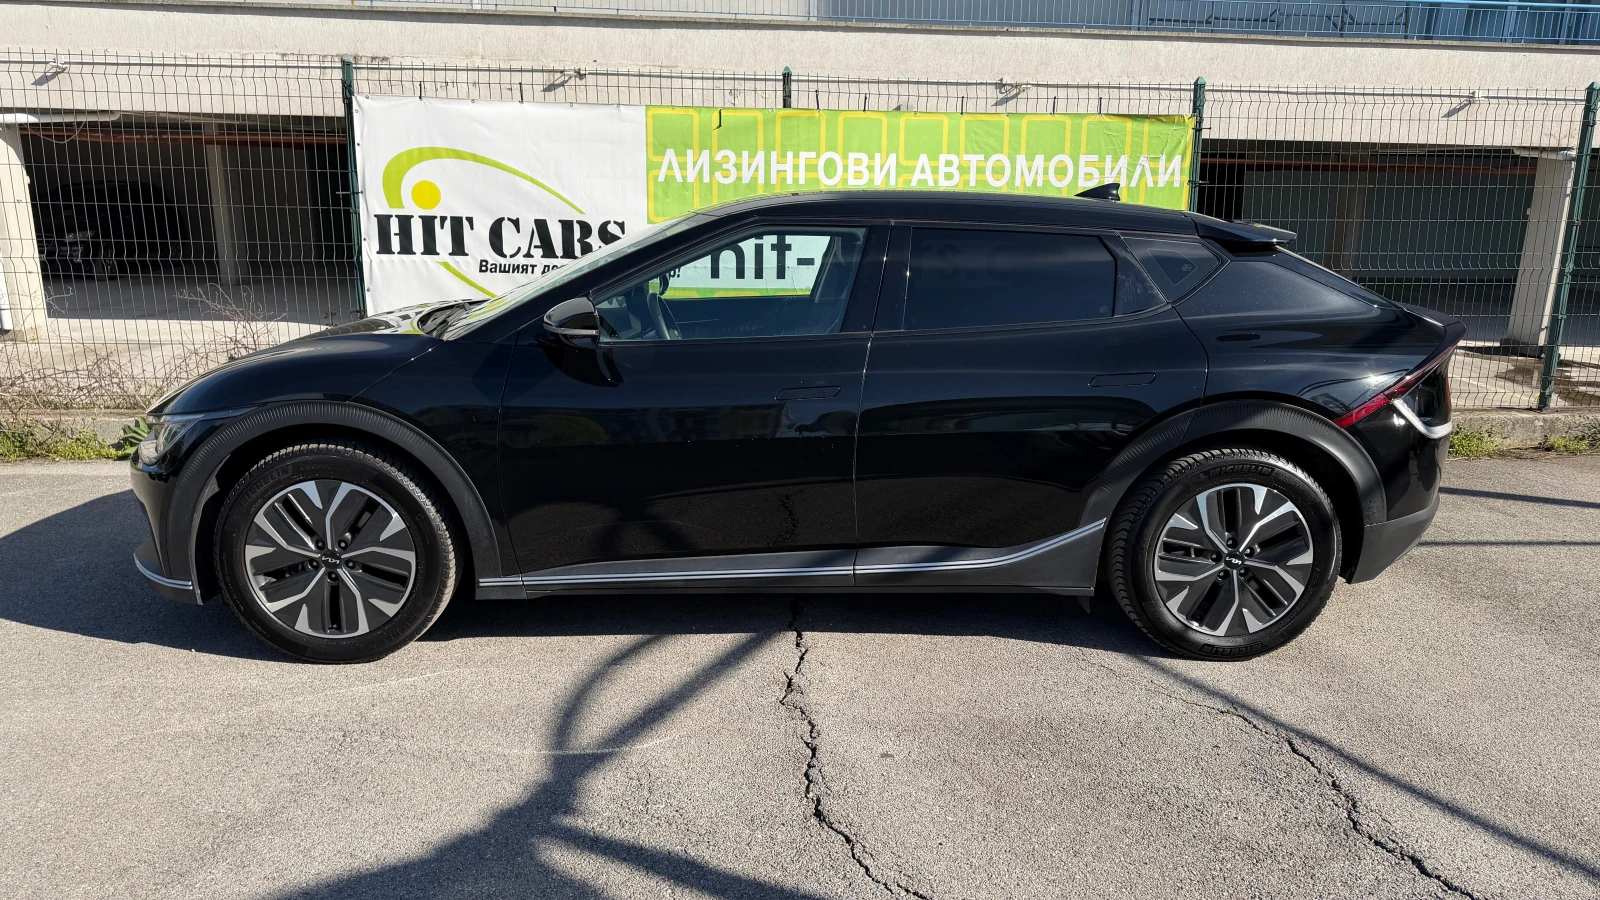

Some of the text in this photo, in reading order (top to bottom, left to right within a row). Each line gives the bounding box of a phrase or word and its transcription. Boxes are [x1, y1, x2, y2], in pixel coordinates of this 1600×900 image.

[657, 148, 1182, 188] ЛИЗИНГОВИ АВТОМОБИЛИ
[373, 214, 626, 260] HIT CARS
[479, 259, 538, 274] Вашият
